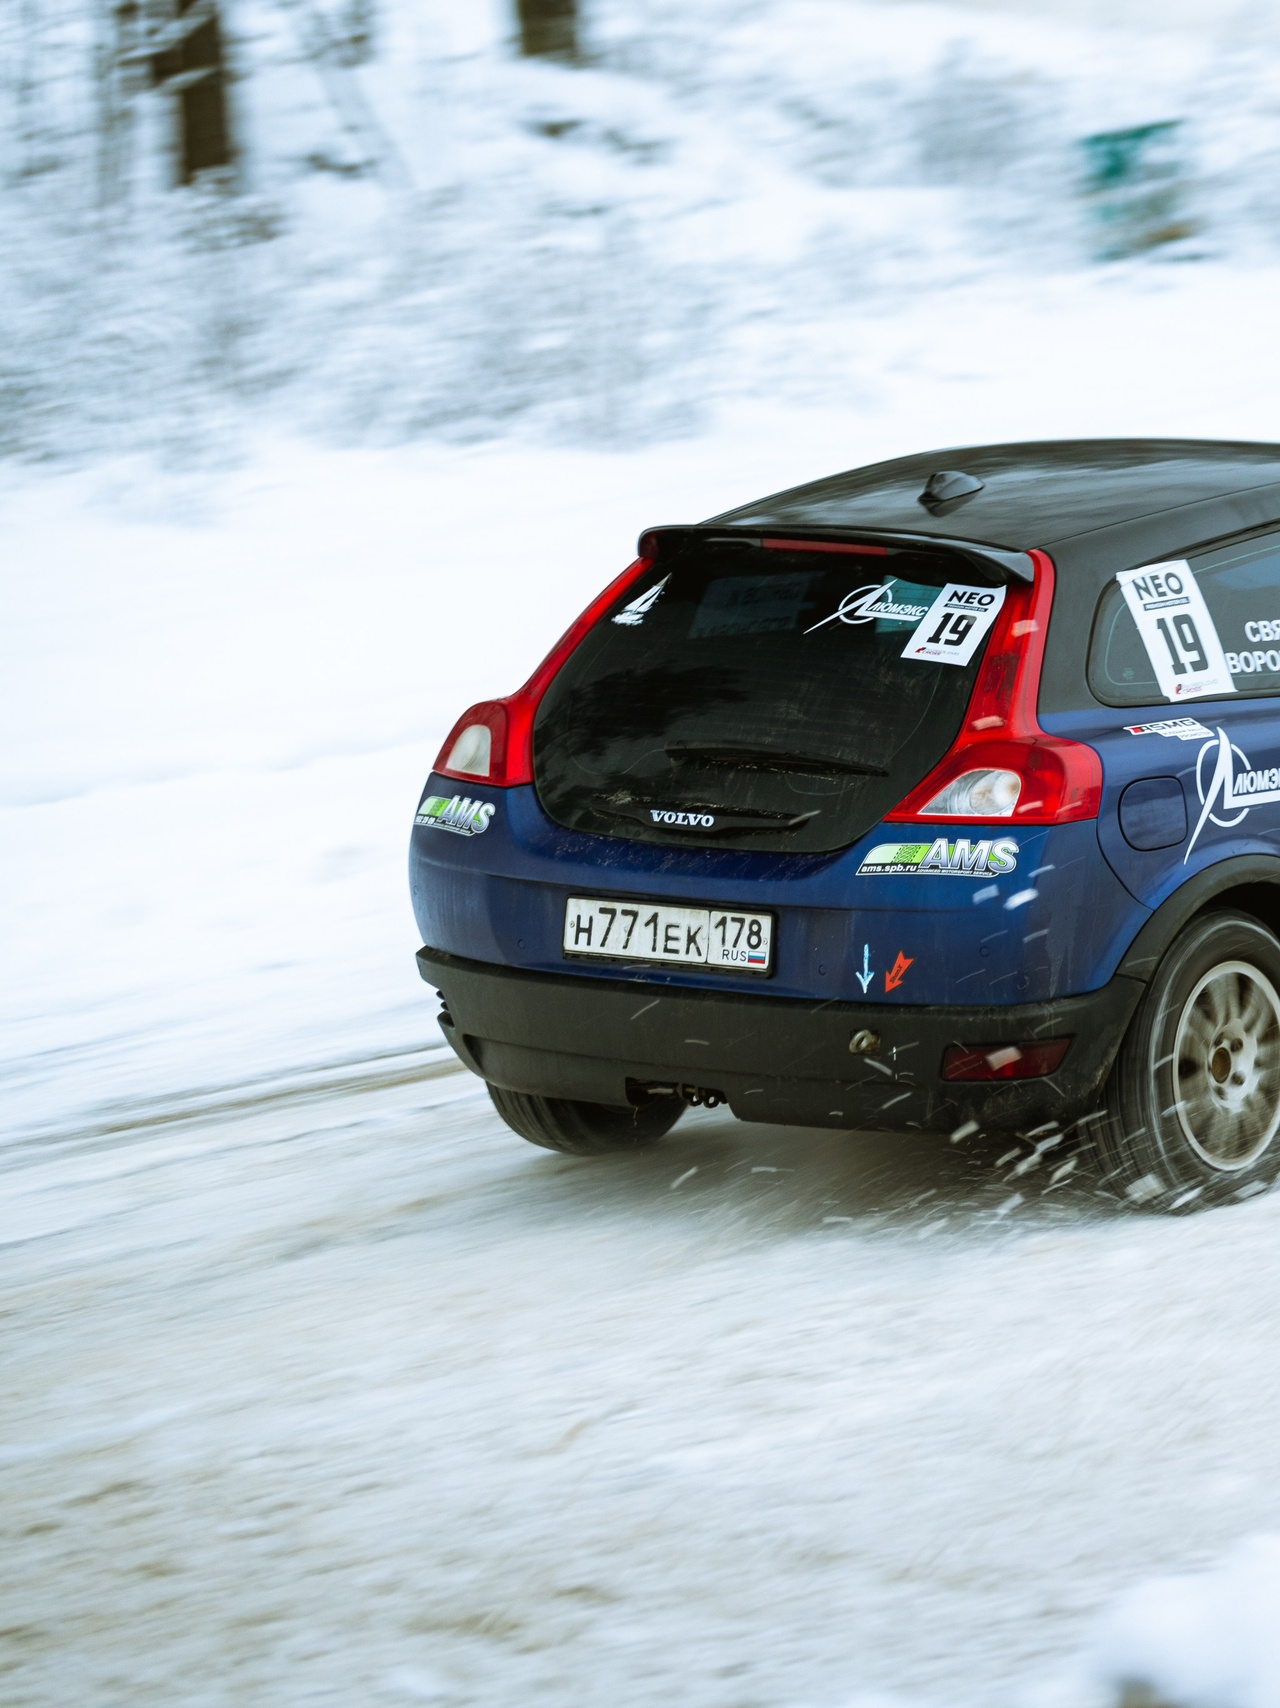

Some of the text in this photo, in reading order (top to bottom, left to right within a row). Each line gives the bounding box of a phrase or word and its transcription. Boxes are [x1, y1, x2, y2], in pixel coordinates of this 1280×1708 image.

[947, 590, 995, 606] NEO
[1132, 572, 1184, 600] NEO
[926, 612, 977, 646] 19
[1156, 614, 1209, 675] 19
[437, 795, 496, 833] AMS
[650, 809, 715, 827] VOLVO
[861, 864, 917, 874] ams.spb.ru
[918, 837, 1019, 873] AMS
[714, 916, 762, 950] 178
[722, 949, 747, 962] RUS
